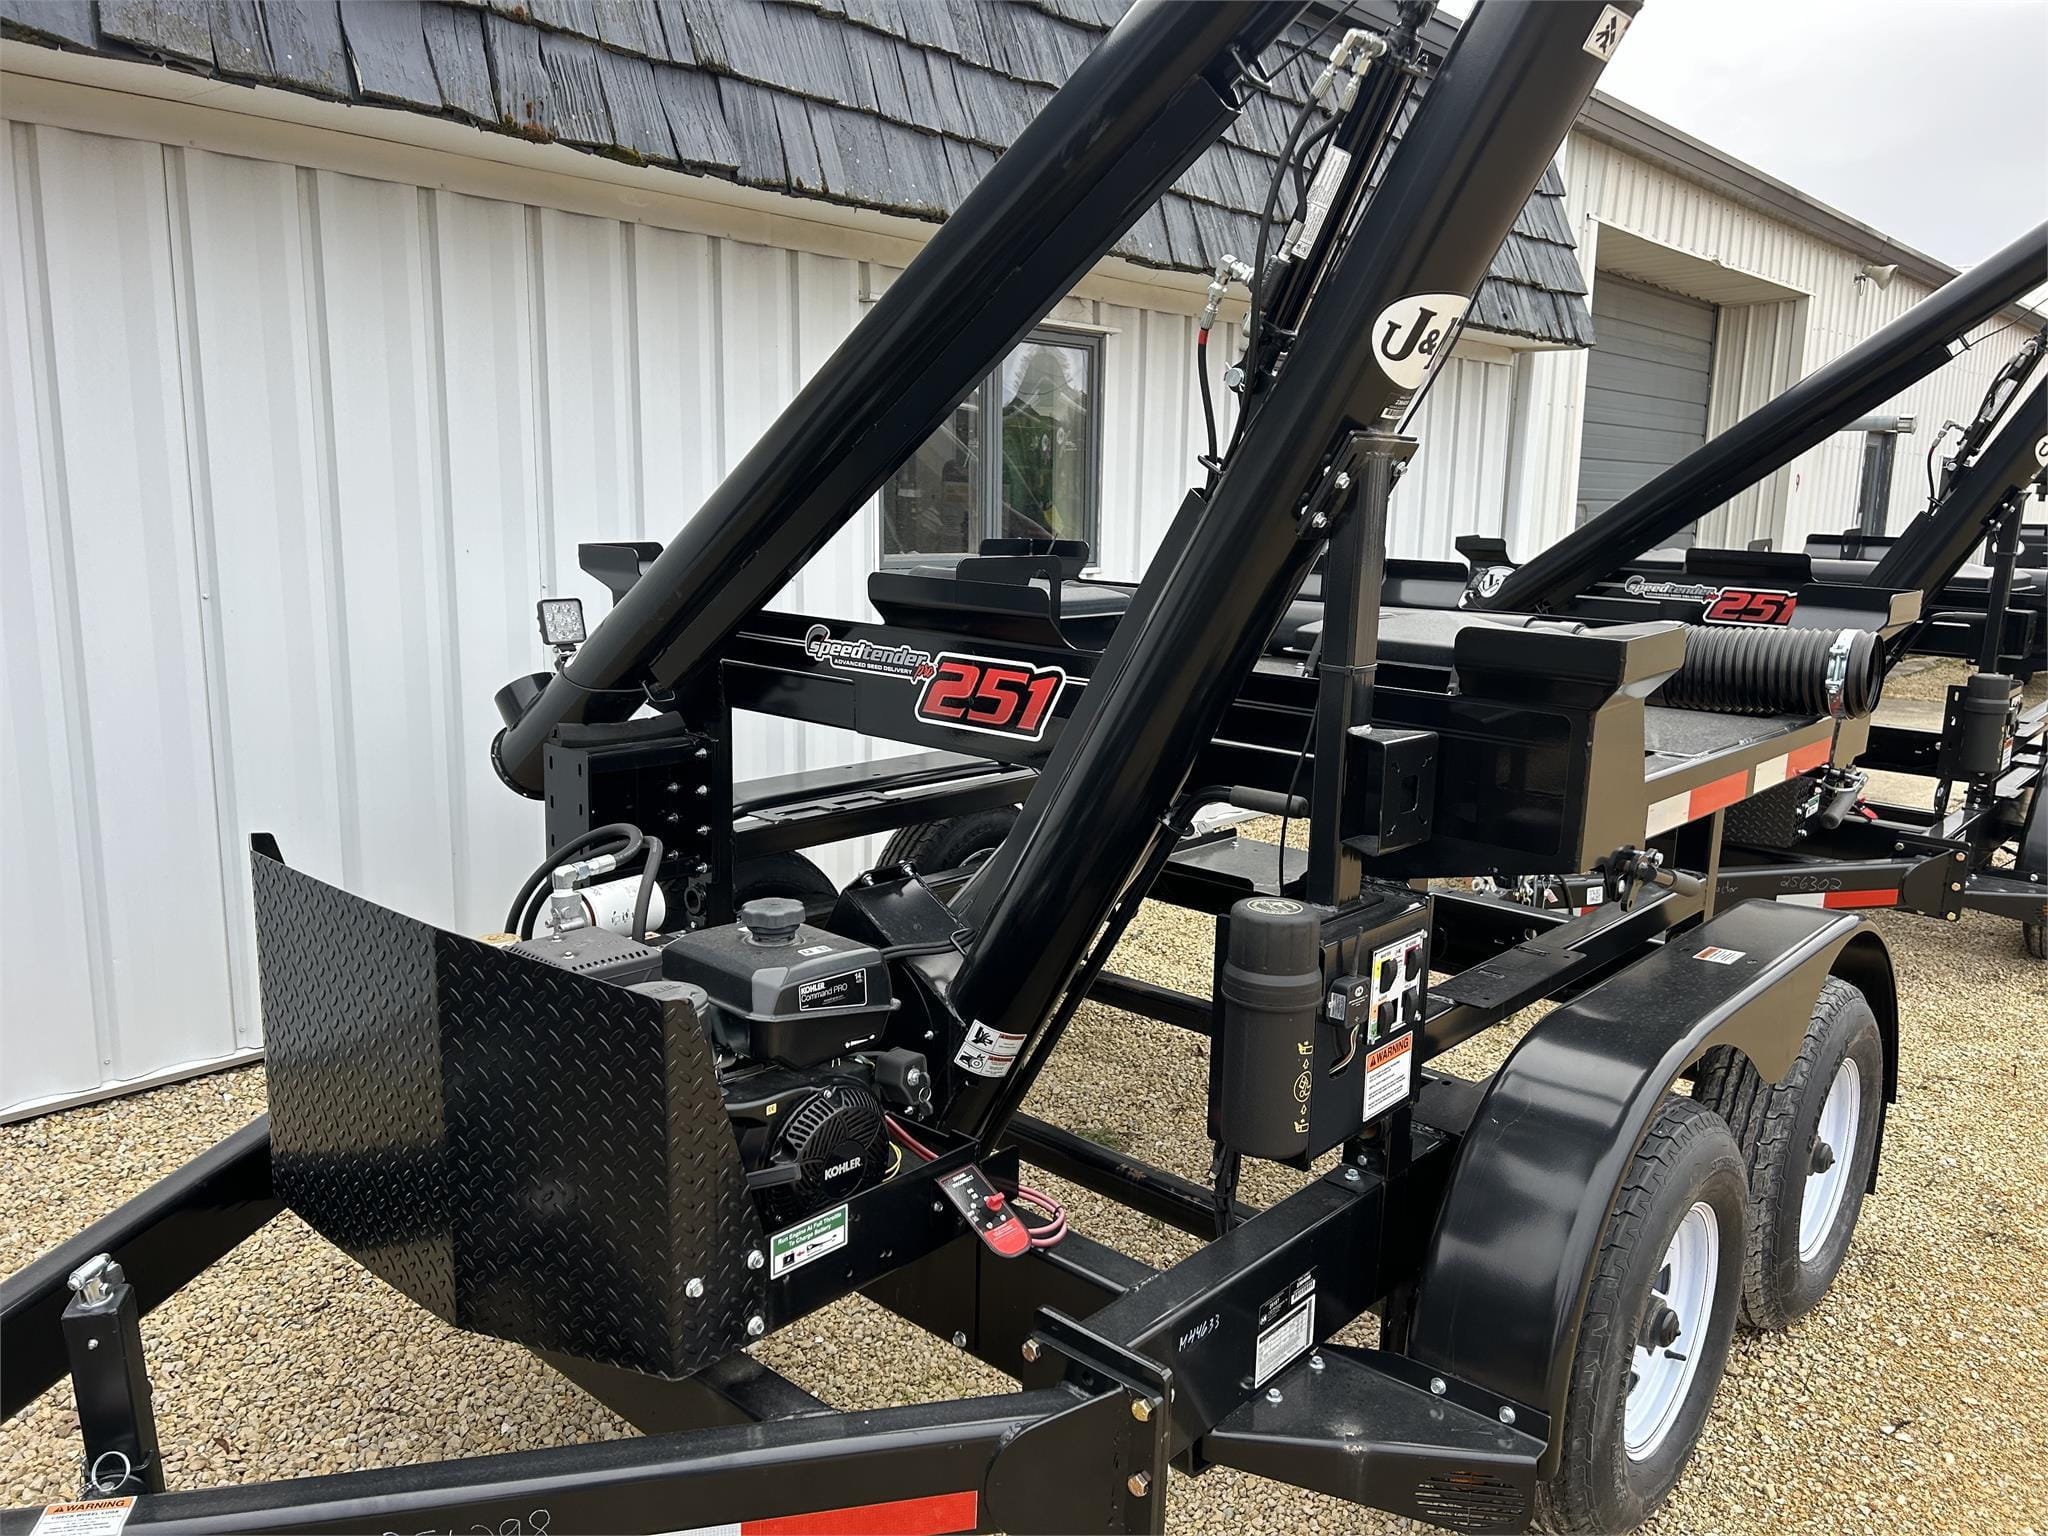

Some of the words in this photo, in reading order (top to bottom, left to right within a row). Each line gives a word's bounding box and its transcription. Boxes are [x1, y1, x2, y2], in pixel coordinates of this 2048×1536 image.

[1381, 306, 1459, 370] J&
[1708, 591, 1798, 624] 251
[808, 641, 928, 667] speedtender
[834, 658, 866, 669] ADVANCED
[866, 662, 882, 671] SEED
[883, 664, 913, 675] DELIVERY
[913, 663, 934, 680] pro
[922, 661, 1058, 731] 251
[1780, 875, 1842, 892] 256302
[801, 982, 826, 995] KOHLER
[801, 986, 832, 1002] Command
[833, 983, 848, 994] PRO
[1376, 1037, 1409, 1061] WARNING
[824, 1156, 861, 1180] KOHLER
[66, 1499, 125, 1513] WARNING
